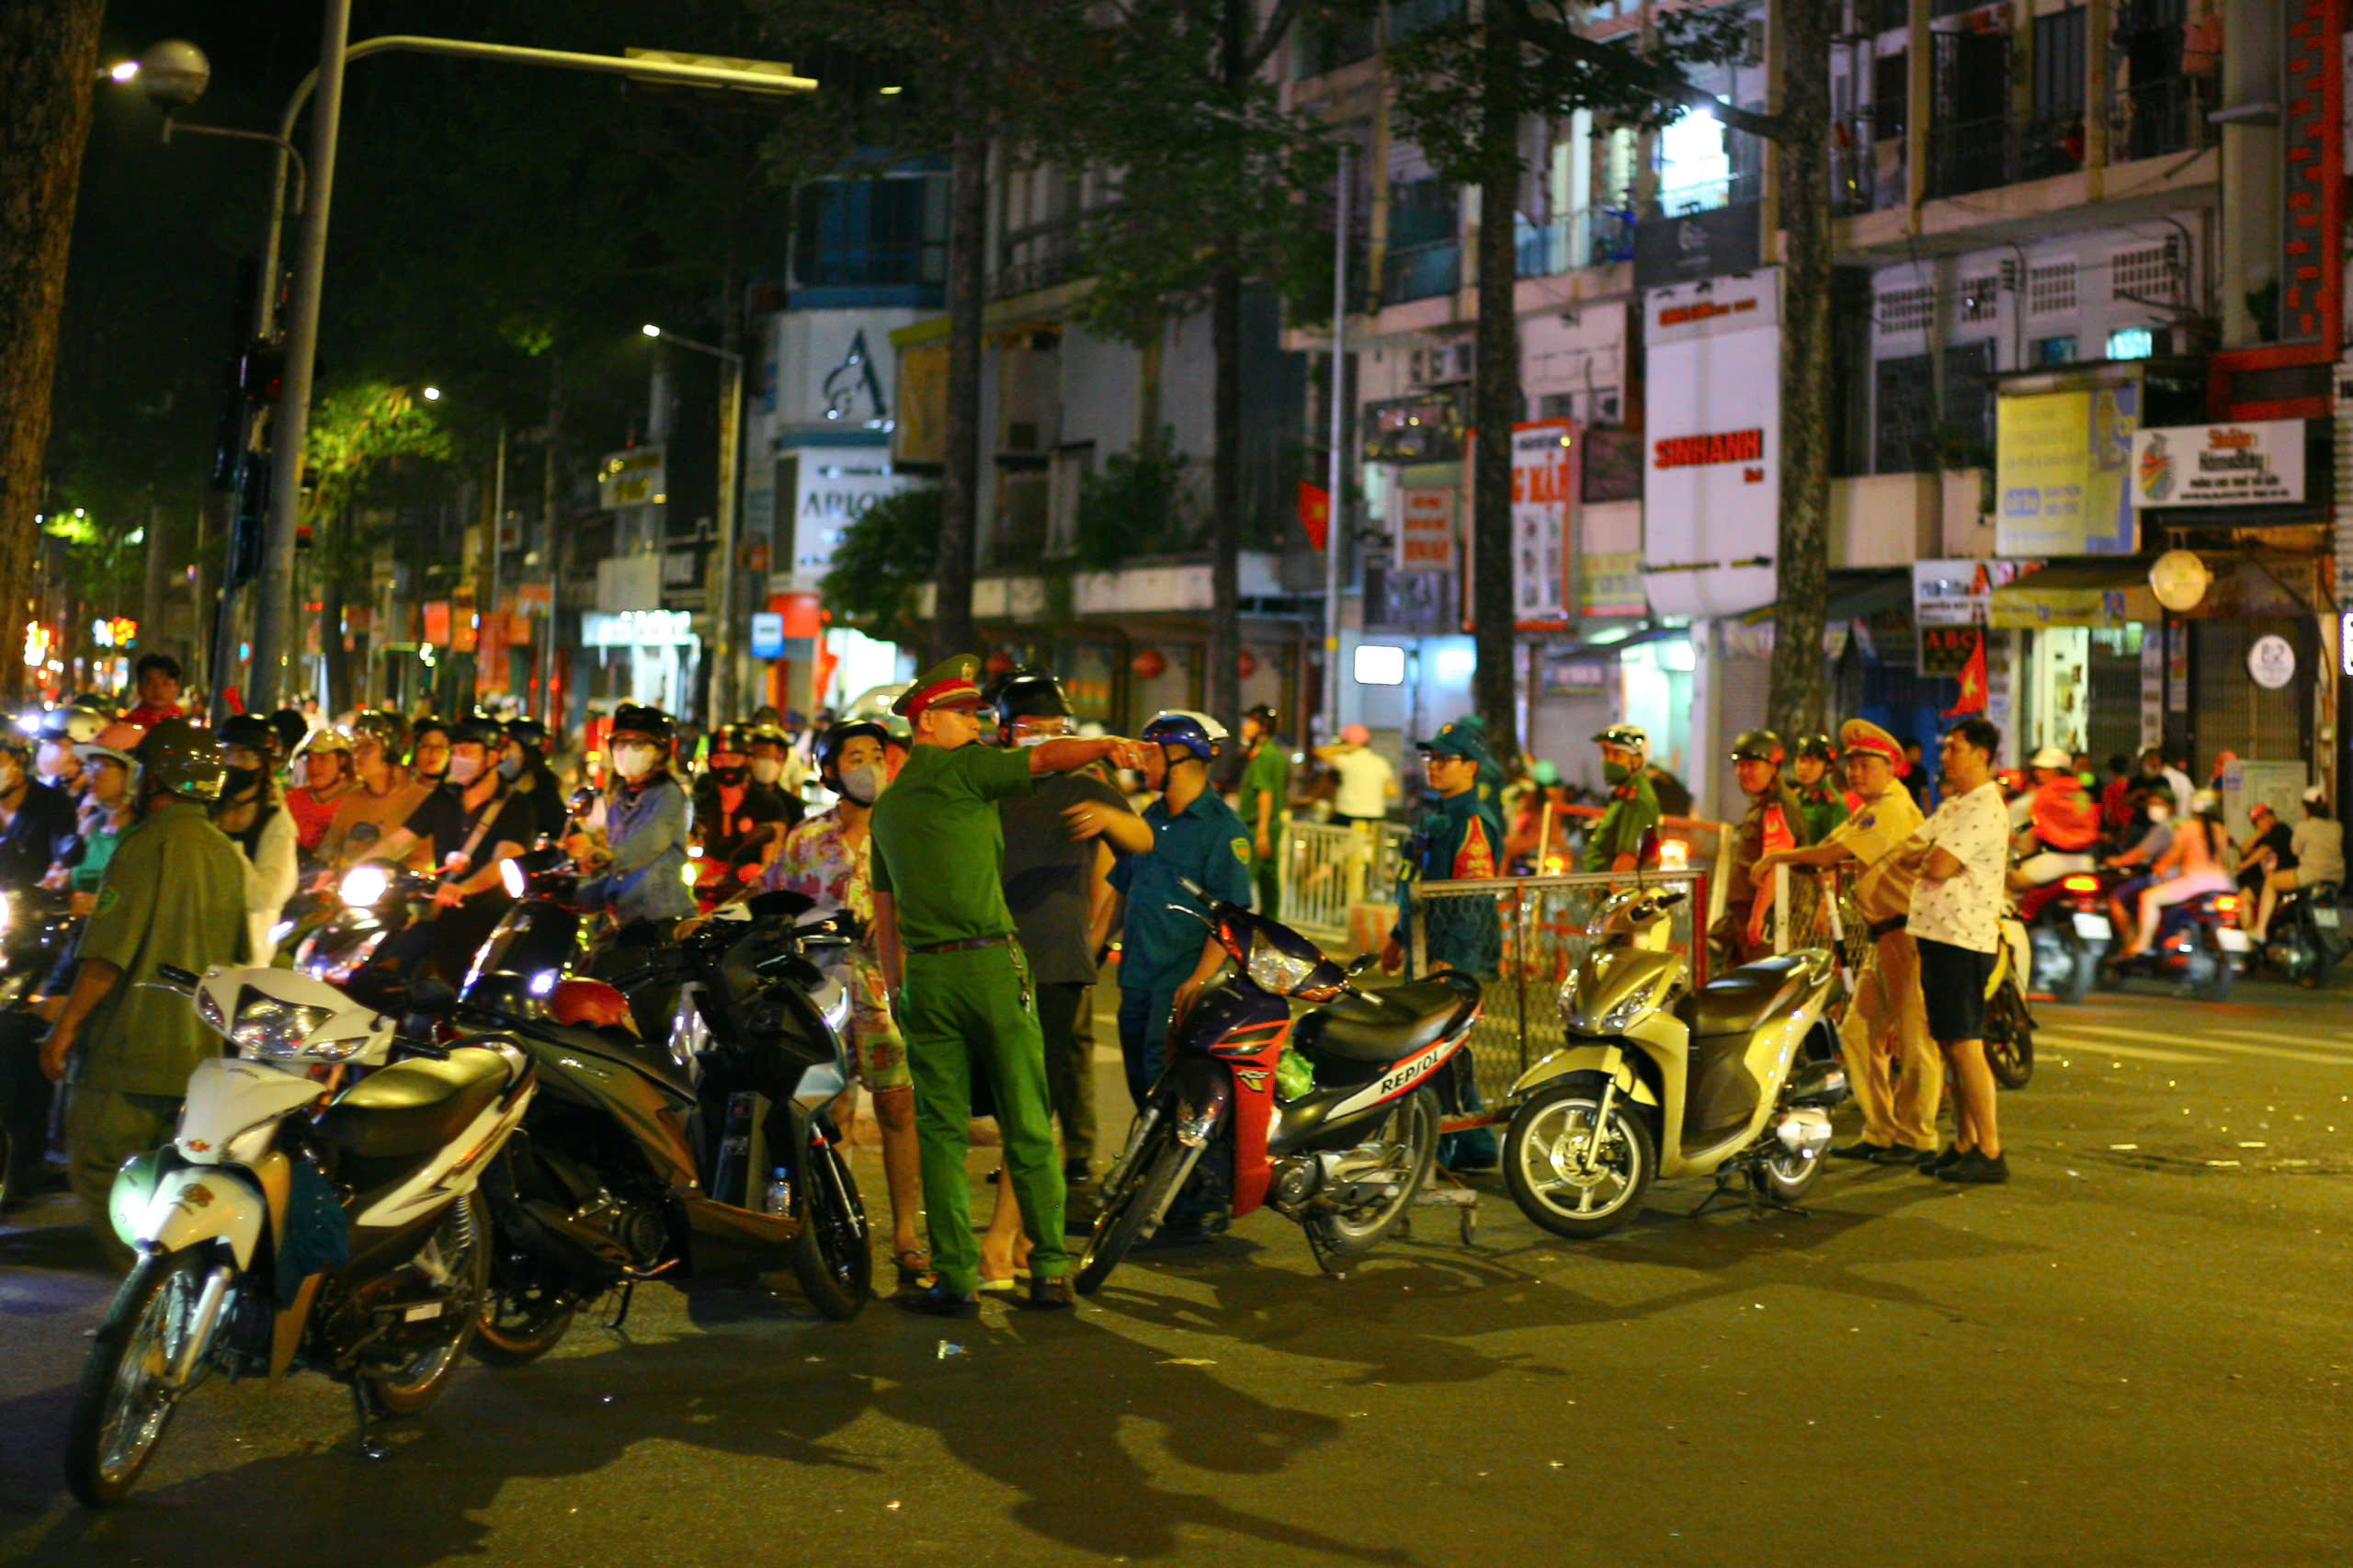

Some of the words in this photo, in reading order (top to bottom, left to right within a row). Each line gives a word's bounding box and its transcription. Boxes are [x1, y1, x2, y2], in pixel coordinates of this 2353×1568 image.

[1654, 428, 1764, 470] SINHANH
[802, 491, 888, 517] APLO
[1381, 1050, 1438, 1095] REPSOL
